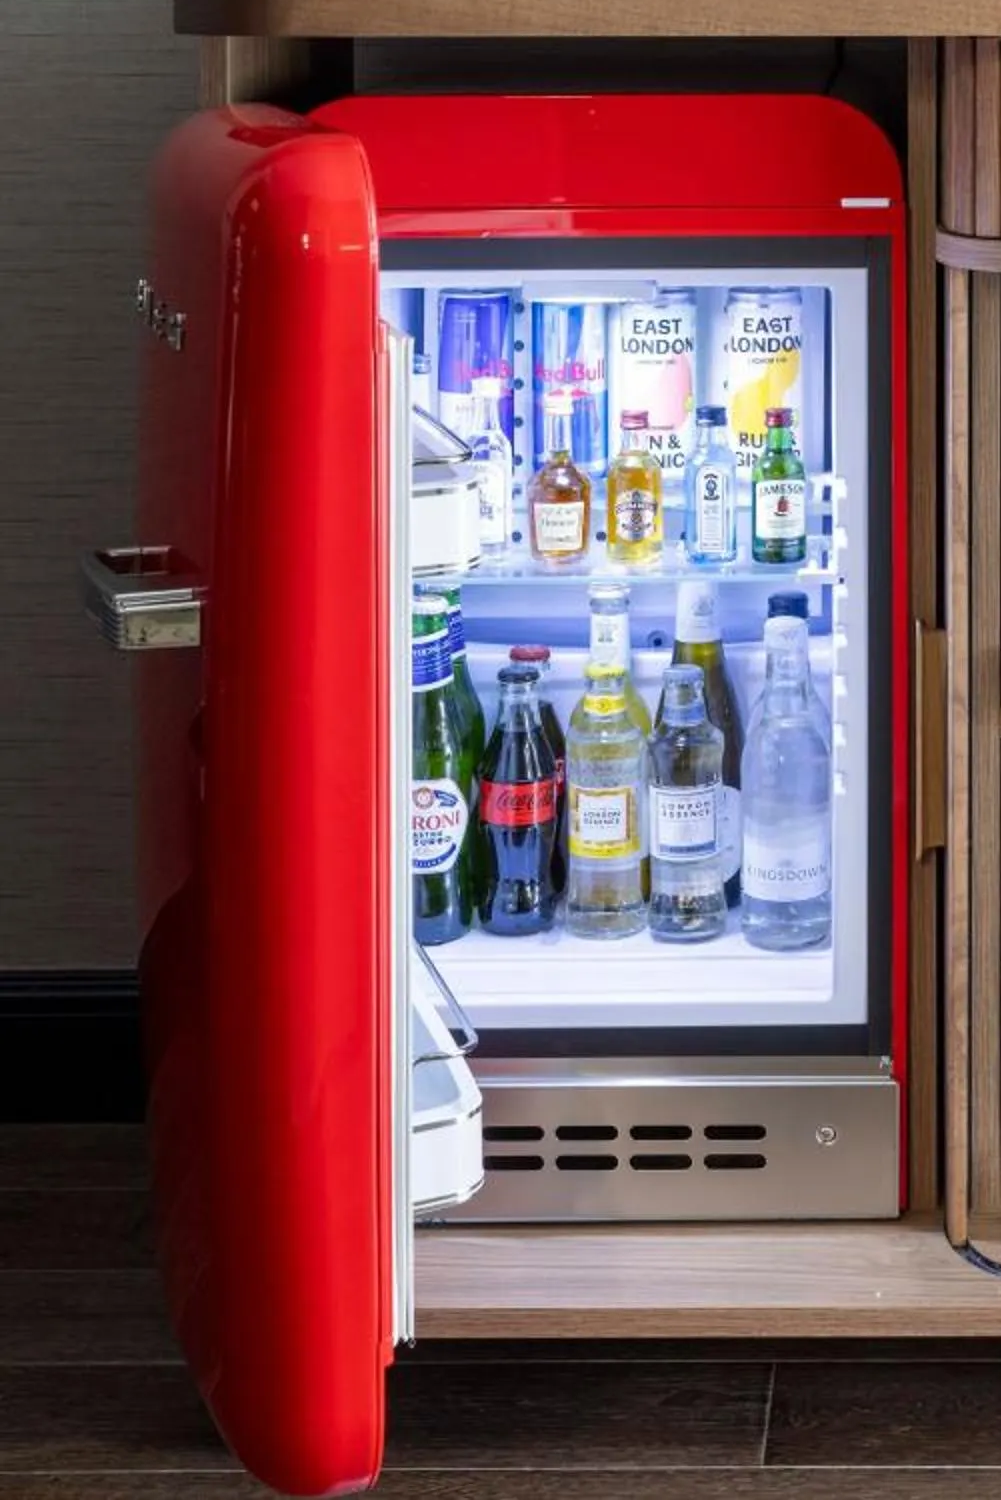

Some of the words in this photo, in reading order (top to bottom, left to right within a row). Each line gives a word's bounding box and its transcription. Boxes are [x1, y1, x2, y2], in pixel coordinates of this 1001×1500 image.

[633, 318, 682, 335] EAST
[743, 316, 792, 333] EAST
[621, 336, 694, 354] LONDON
[571, 359, 605, 381] Bull
[739, 432, 765, 449] RU
[412, 811, 460, 831] RONI
